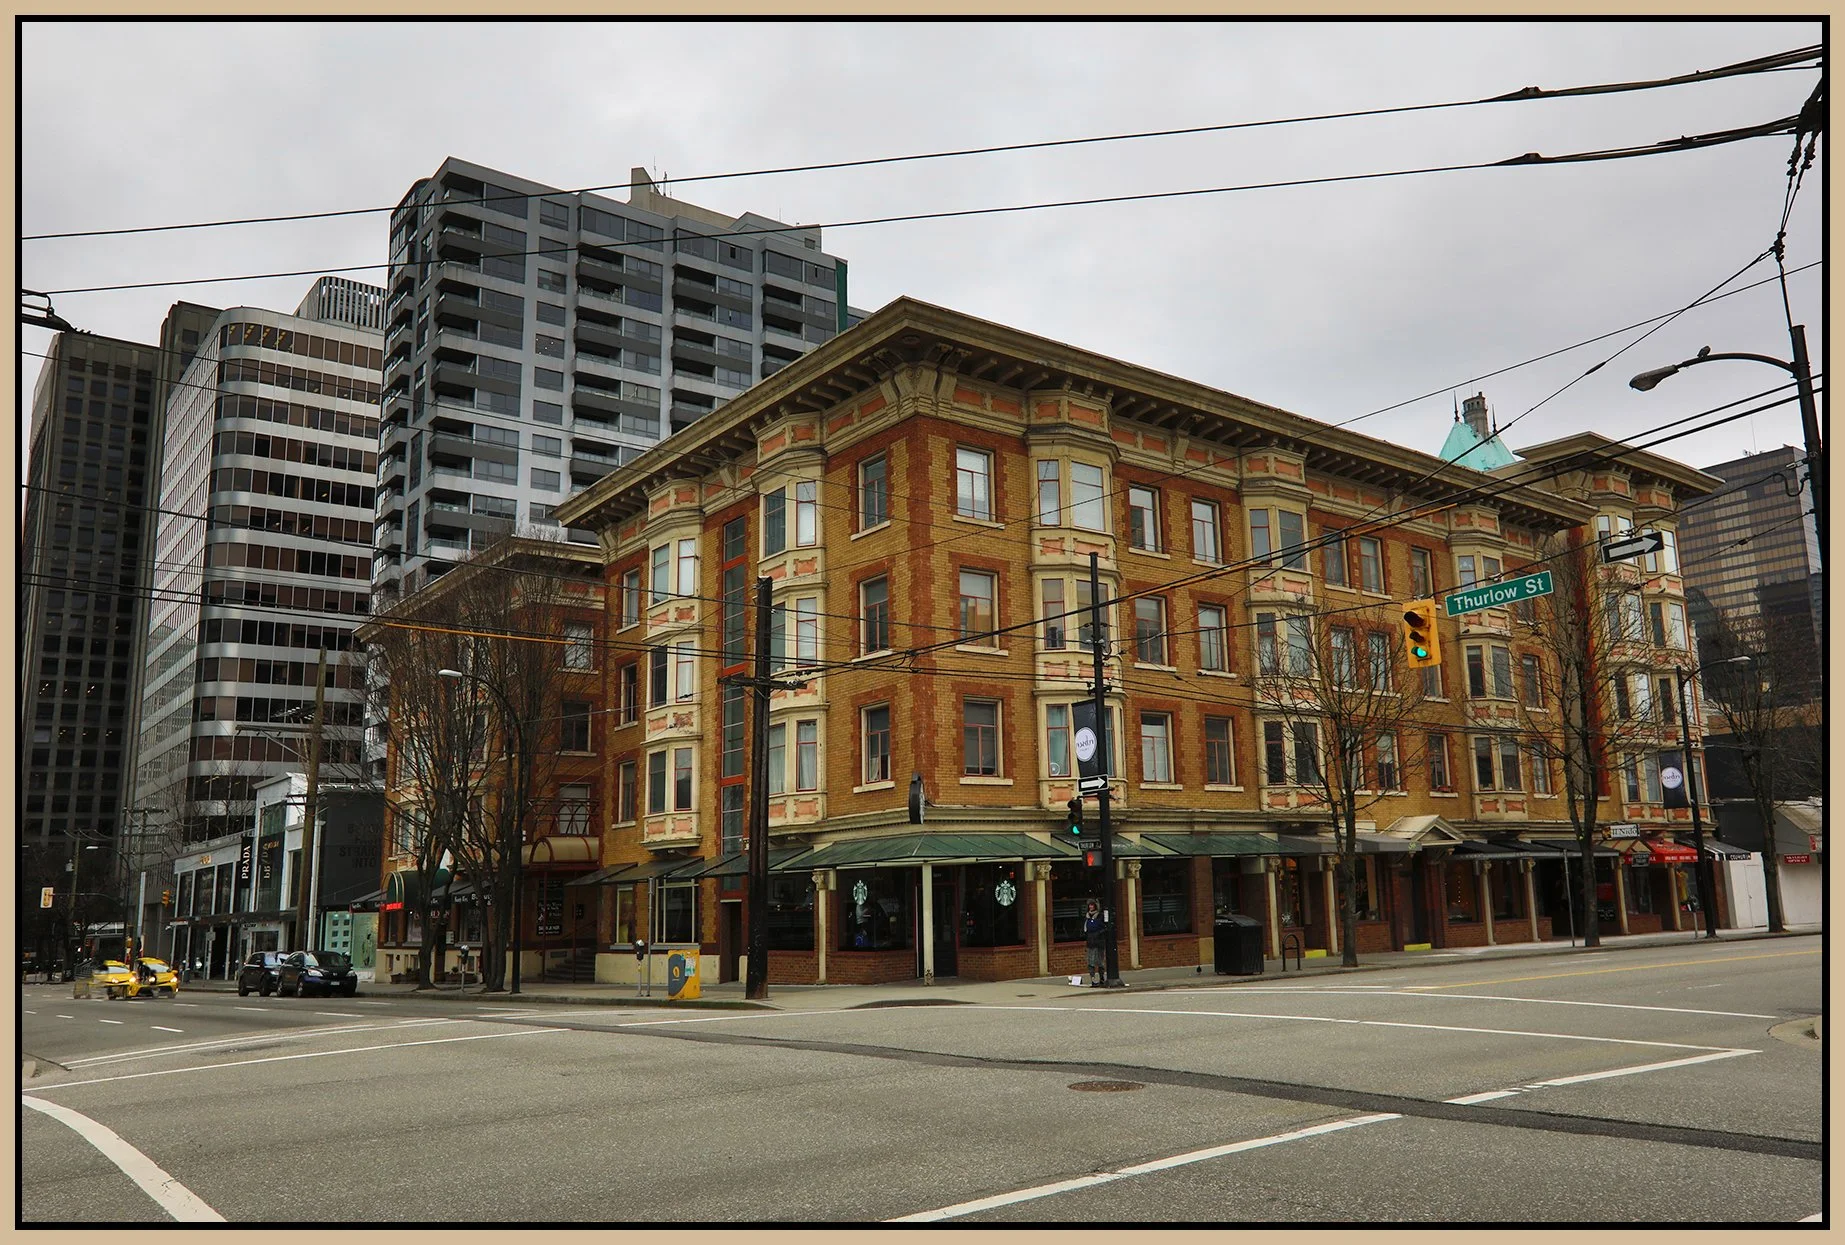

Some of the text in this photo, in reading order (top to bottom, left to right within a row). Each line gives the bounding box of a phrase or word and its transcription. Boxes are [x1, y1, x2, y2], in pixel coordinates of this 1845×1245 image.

[1453, 578, 1545, 611] Thurlow St
[242, 845, 251, 880] PRADA
